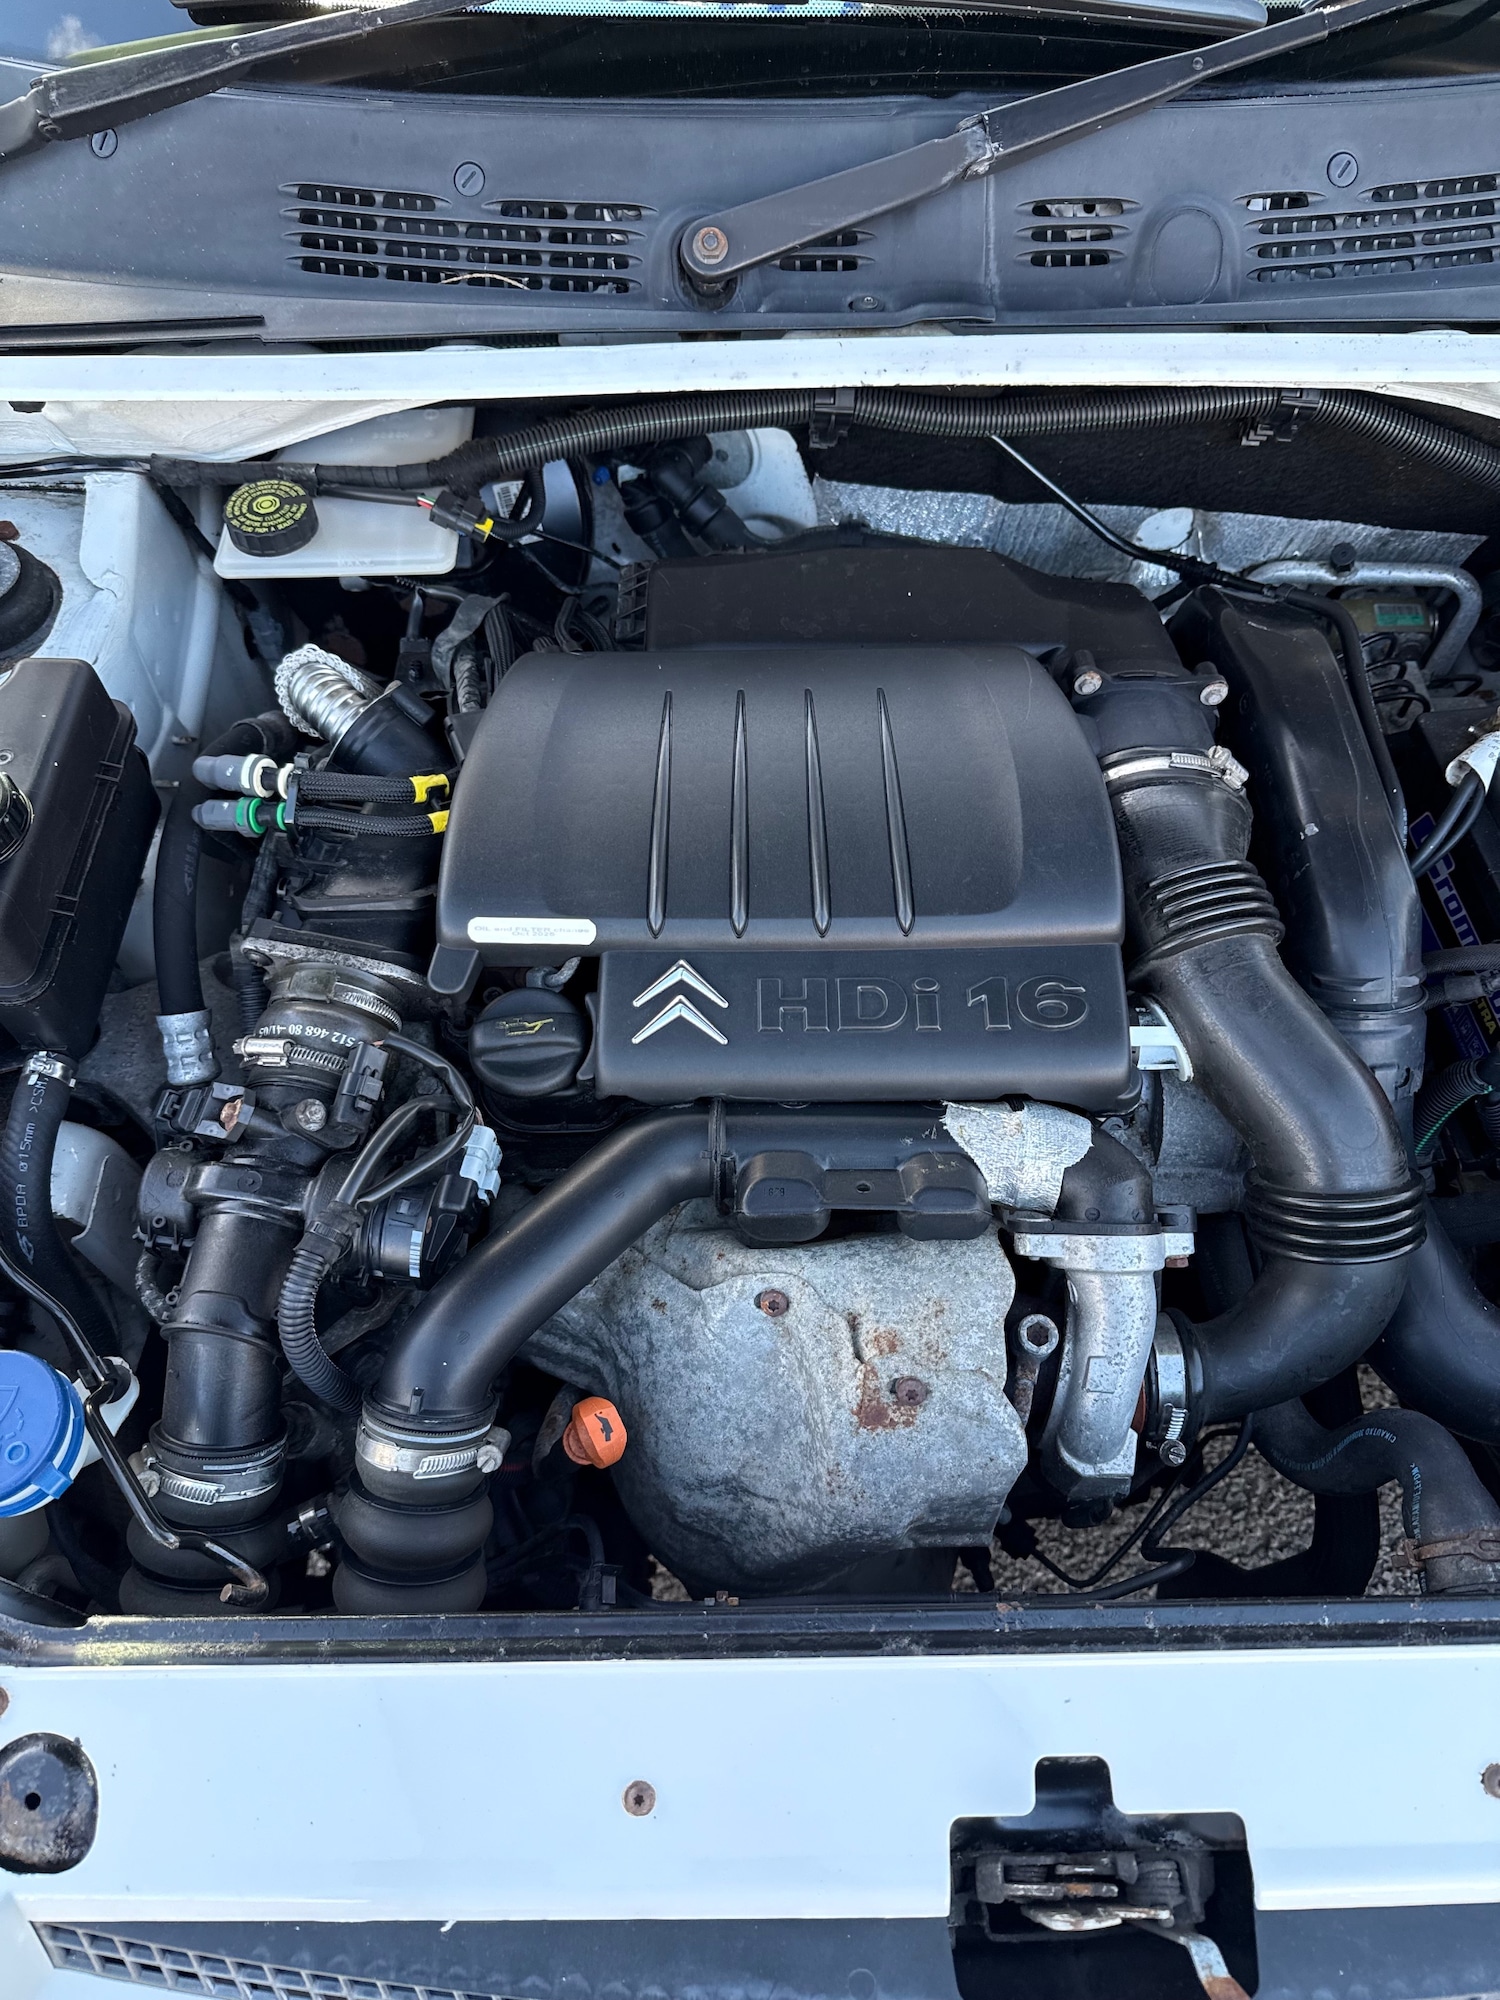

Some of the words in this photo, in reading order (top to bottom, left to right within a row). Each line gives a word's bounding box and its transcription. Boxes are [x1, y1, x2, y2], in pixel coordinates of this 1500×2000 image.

[757, 977, 942, 1032] HDi
[966, 975, 1089, 1032] 16
[288, 1023, 303, 1036] 80
[304, 1025, 330, 1039] 468
